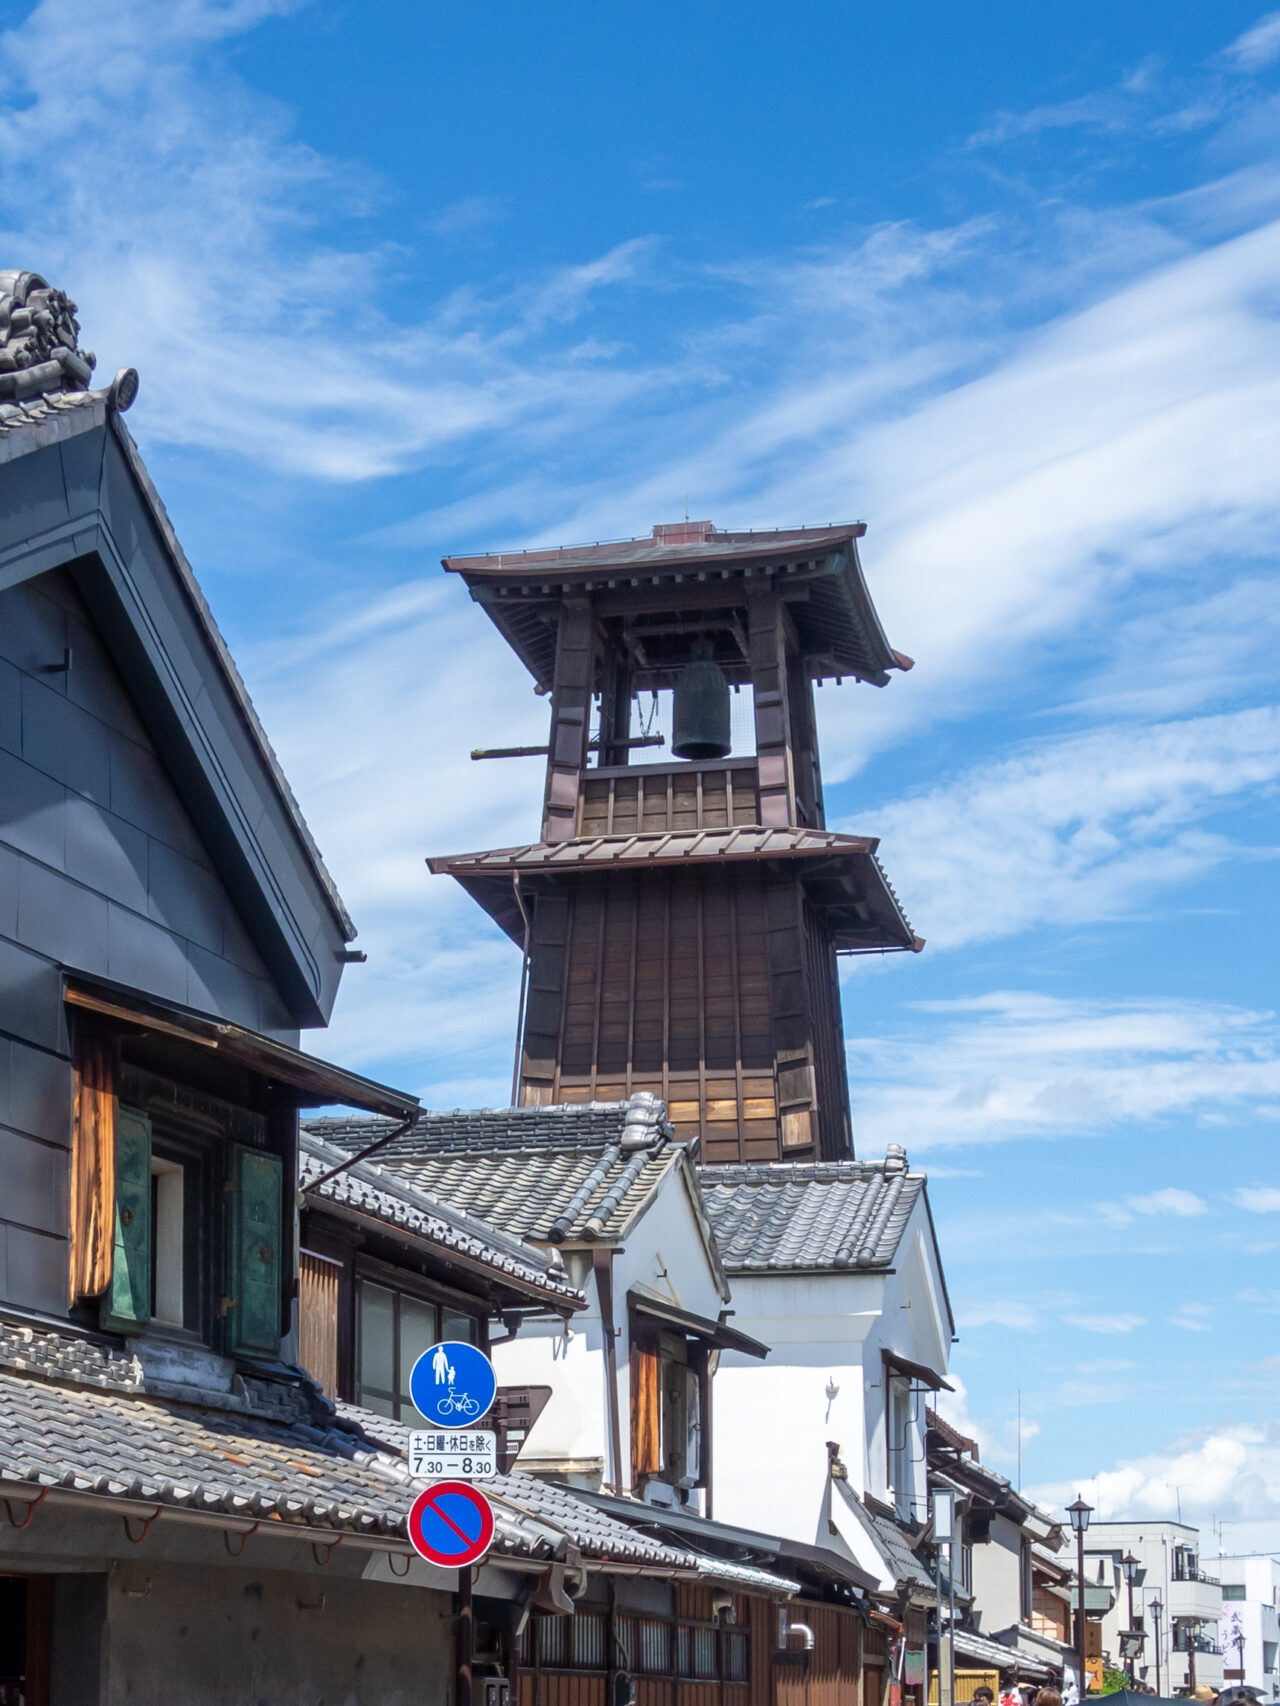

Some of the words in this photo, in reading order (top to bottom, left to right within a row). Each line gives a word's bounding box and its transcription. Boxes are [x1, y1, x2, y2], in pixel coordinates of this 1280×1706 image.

[414, 1434, 492, 1452] 土・日曜・休日を除く
